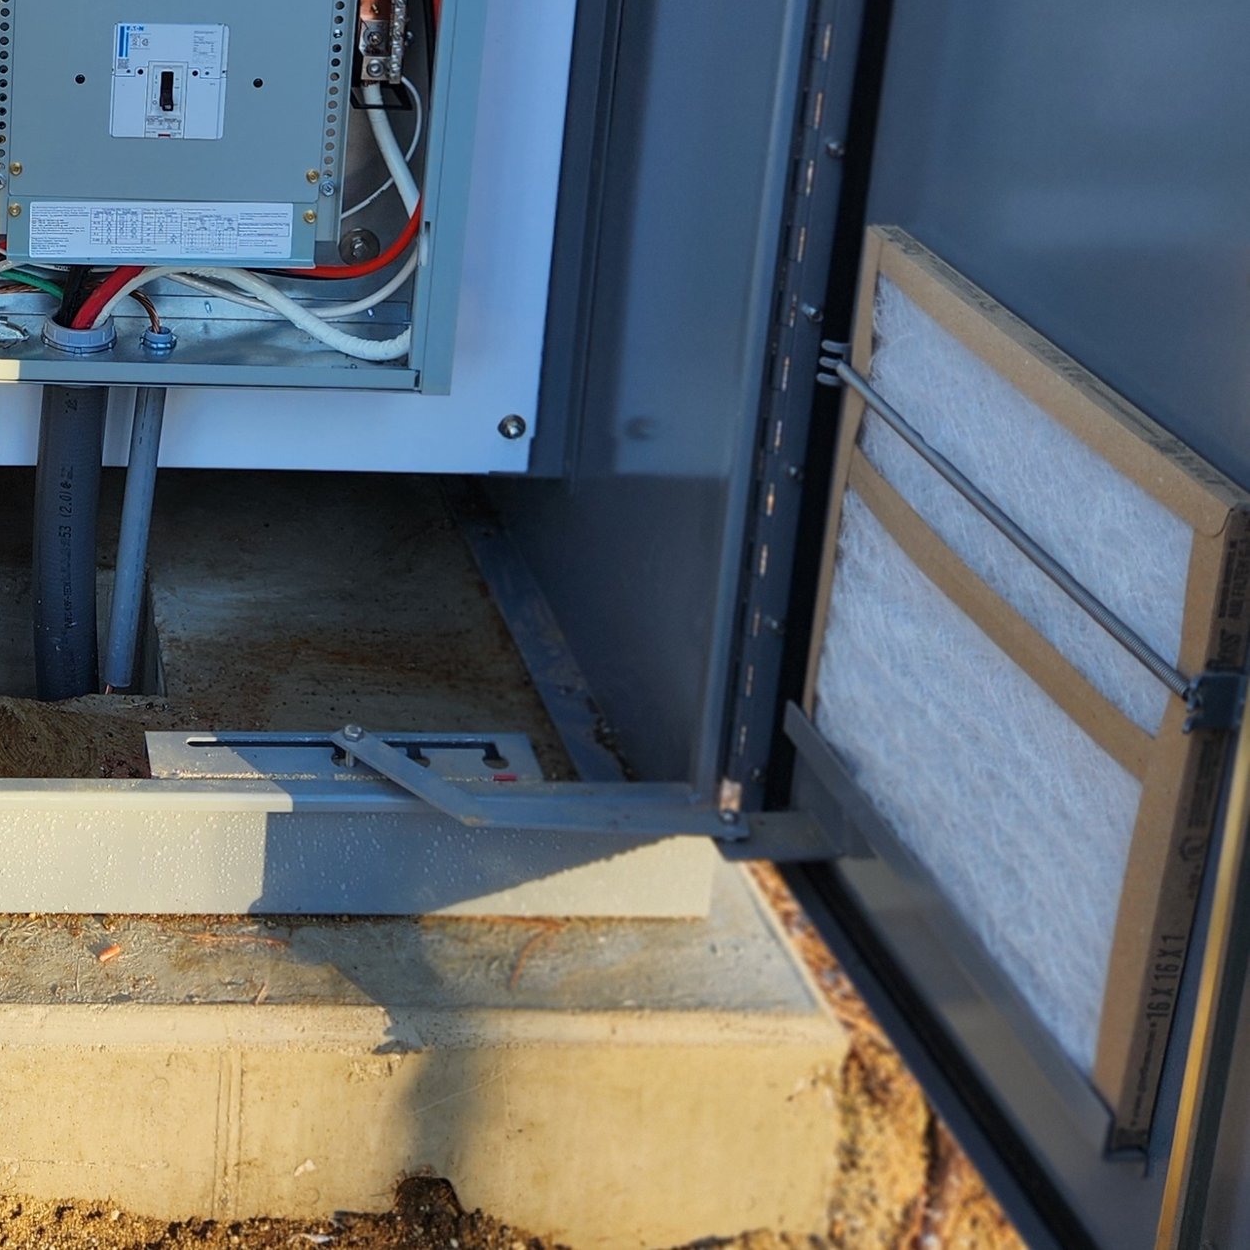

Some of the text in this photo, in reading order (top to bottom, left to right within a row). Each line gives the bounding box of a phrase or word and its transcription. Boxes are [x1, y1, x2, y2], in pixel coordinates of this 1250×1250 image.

[58, 491, 73, 518] (2.0)
[58, 525, 72, 539] 53
[1161, 934, 1185, 943] 1
[1158, 948, 1183, 959] X
[1154, 963, 1179, 981] 16
[1151, 987, 1175, 997] X
[1147, 1002, 1171, 1020] 16
